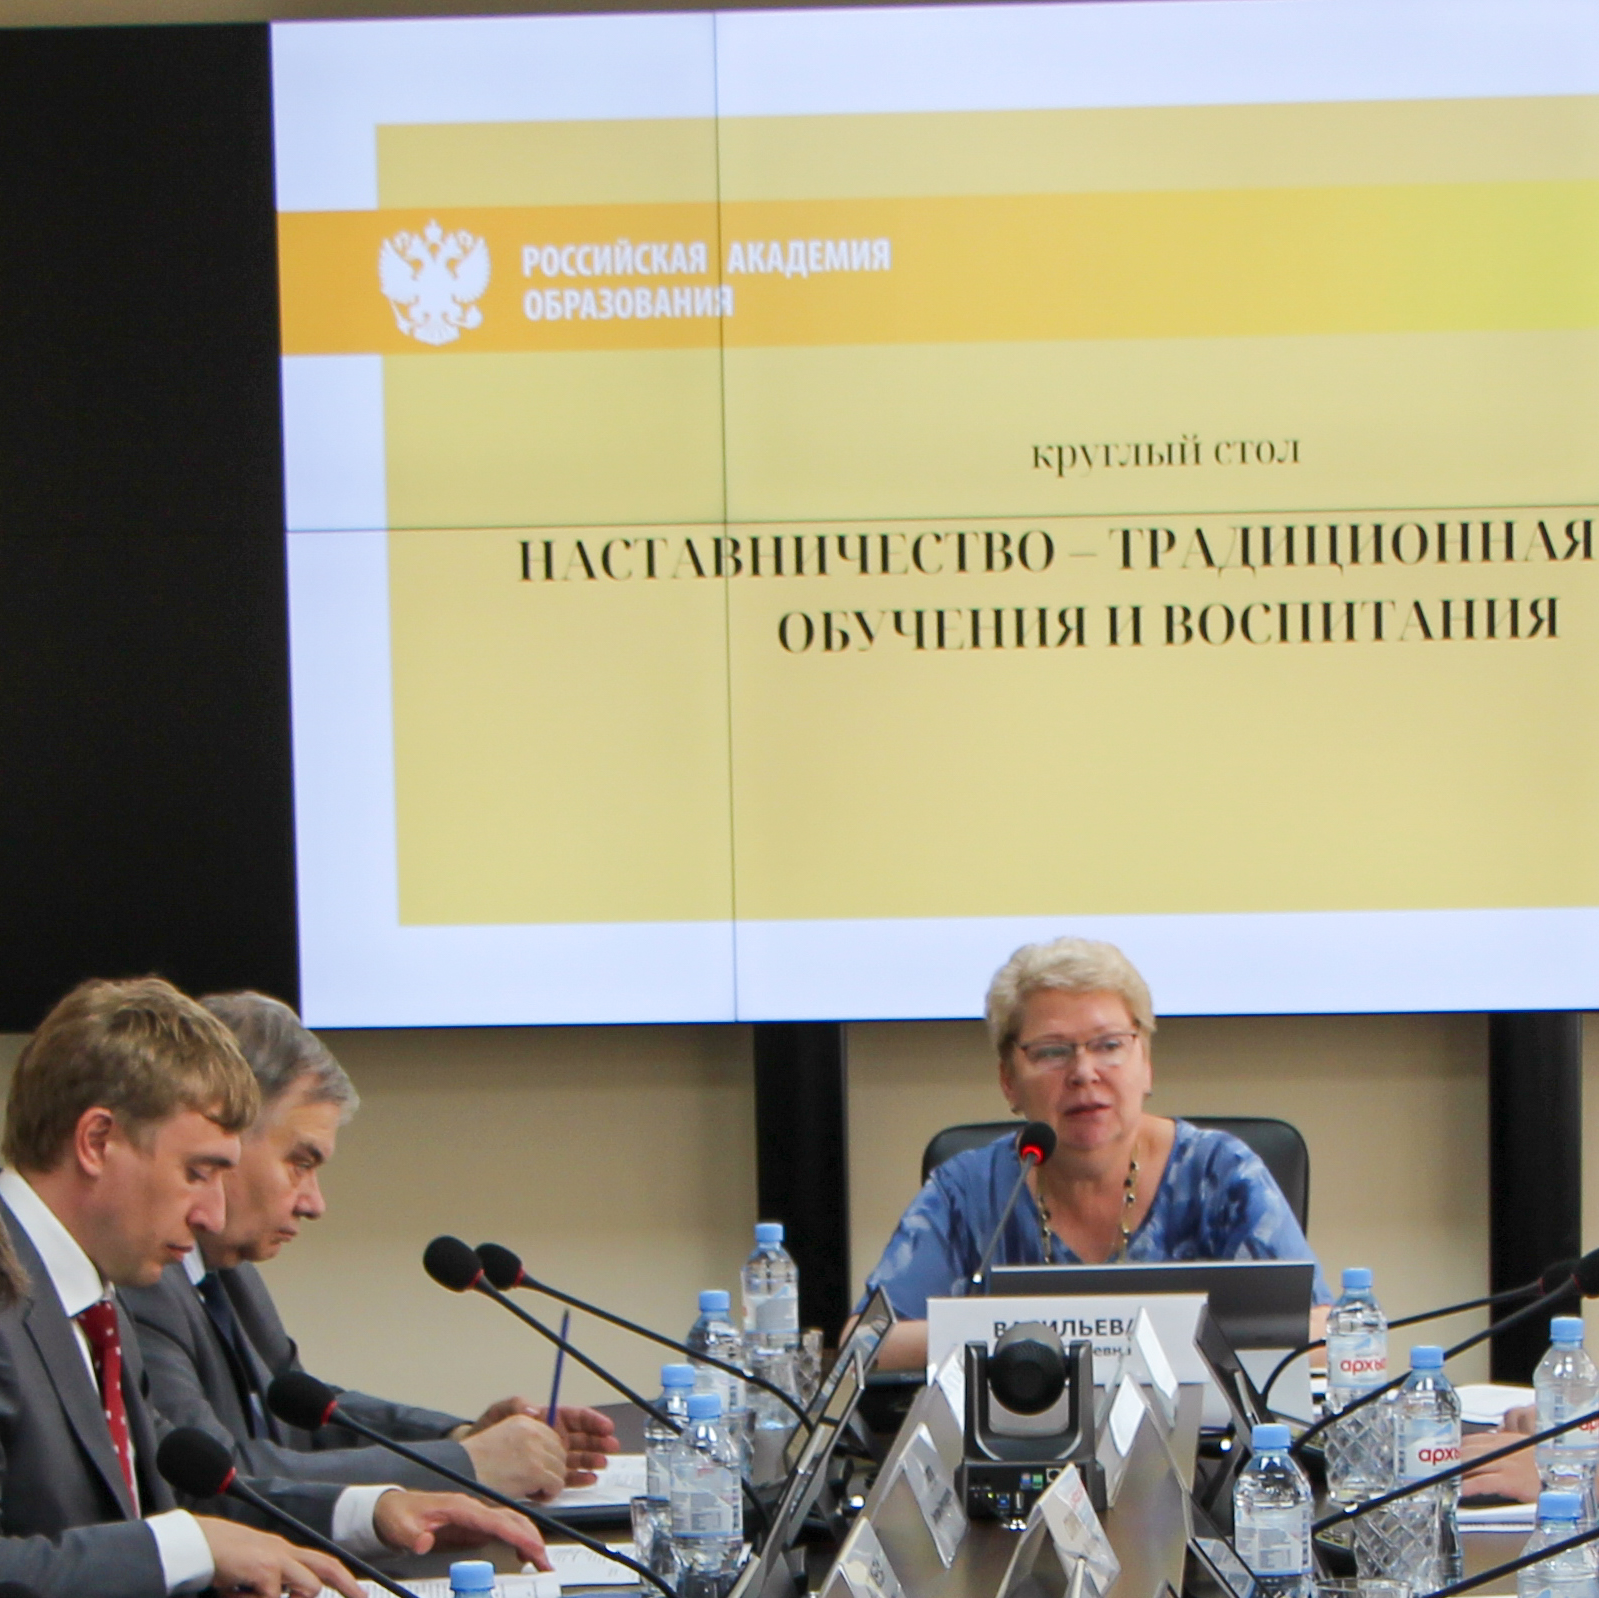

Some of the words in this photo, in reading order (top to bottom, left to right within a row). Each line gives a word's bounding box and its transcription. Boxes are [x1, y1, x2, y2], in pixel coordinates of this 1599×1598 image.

[522, 240, 707, 277] РОССИЙСКАЯ
[724, 237, 894, 279] АКАДЕМИЯ
[524, 285, 734, 320] ОБРАЗОВАНИЯ
[1032, 434, 1201, 478] круглый
[1213, 439, 1301, 466] стол
[519, 529, 1055, 582] НАСТАВНИЧЕСТВО
[1108, 518, 1595, 577] ТРАДИЦИОННАЯ
[777, 605, 1086, 653] ОБУЧЕНИЯ
[1106, 604, 1143, 648] И
[1163, 597, 1560, 646] ВОСПИТАНИЯ
